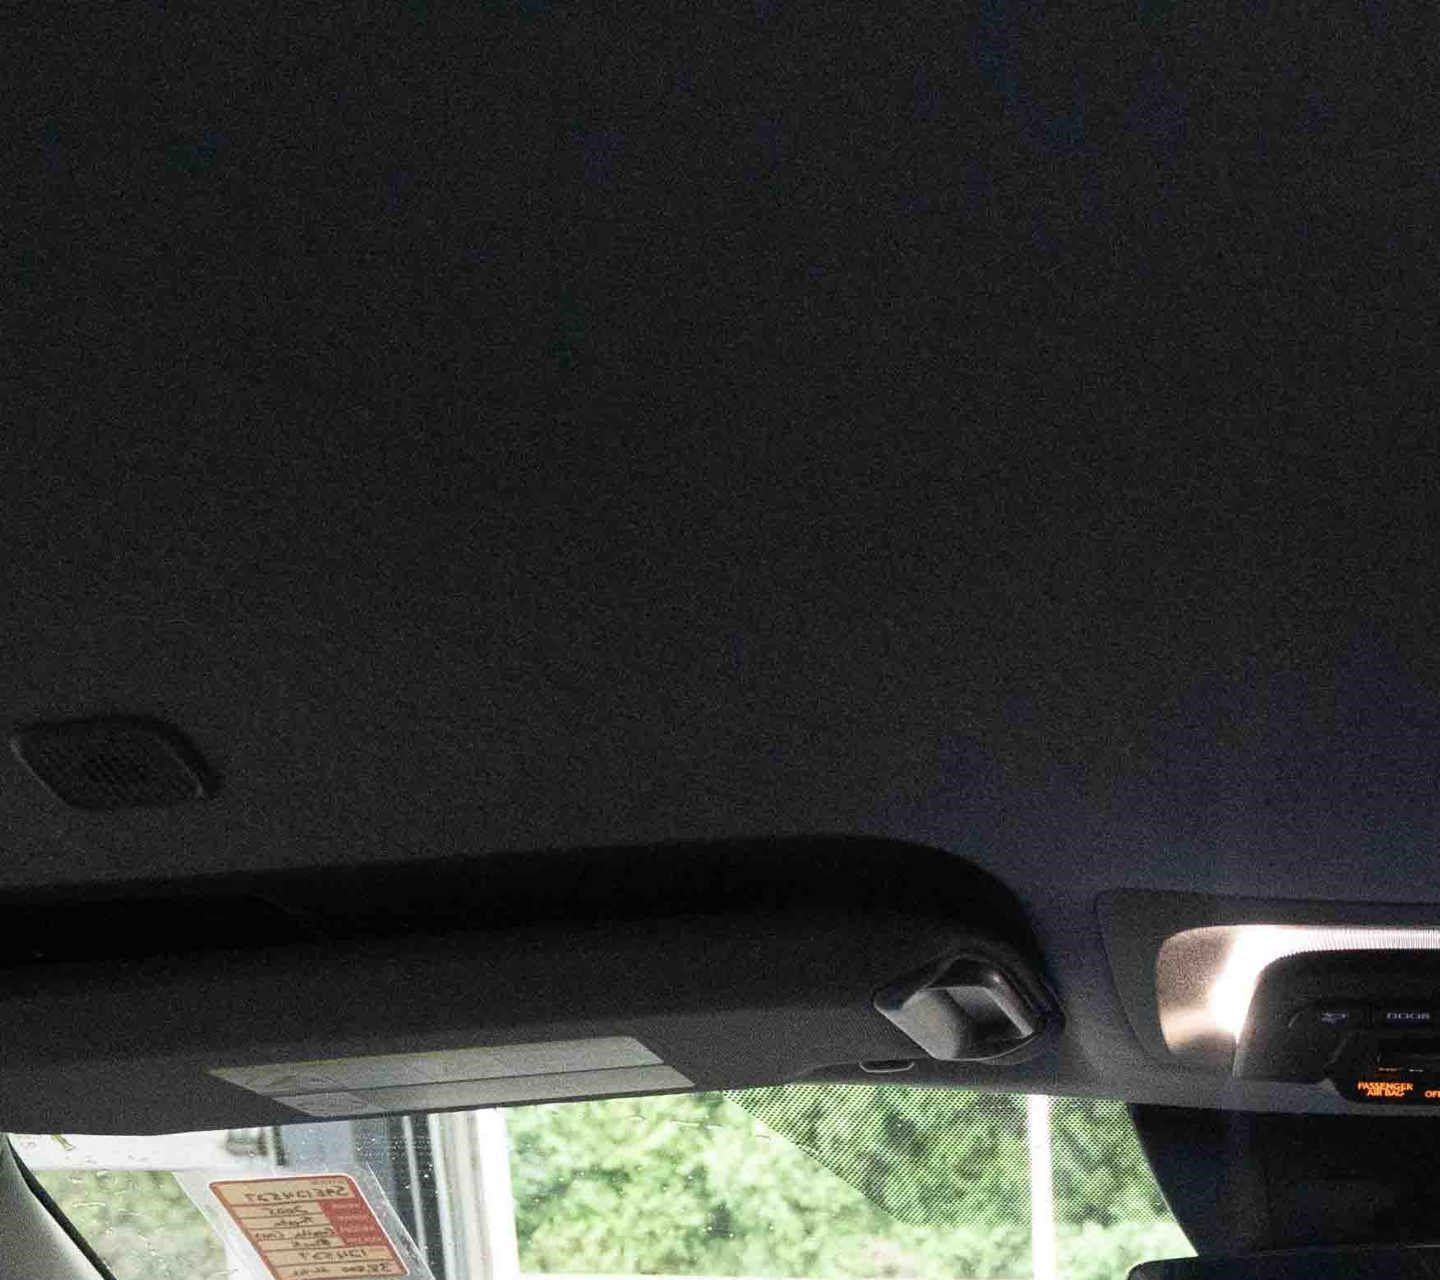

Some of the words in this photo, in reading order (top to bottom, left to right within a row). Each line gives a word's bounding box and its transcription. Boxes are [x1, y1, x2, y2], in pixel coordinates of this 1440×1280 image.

[1387, 1012, 1430, 1020] DOOR
[1357, 1082, 1413, 1091] PASSENGER
[1366, 1089, 1382, 1097] AIR
[1385, 1089, 1405, 1097] BAG
